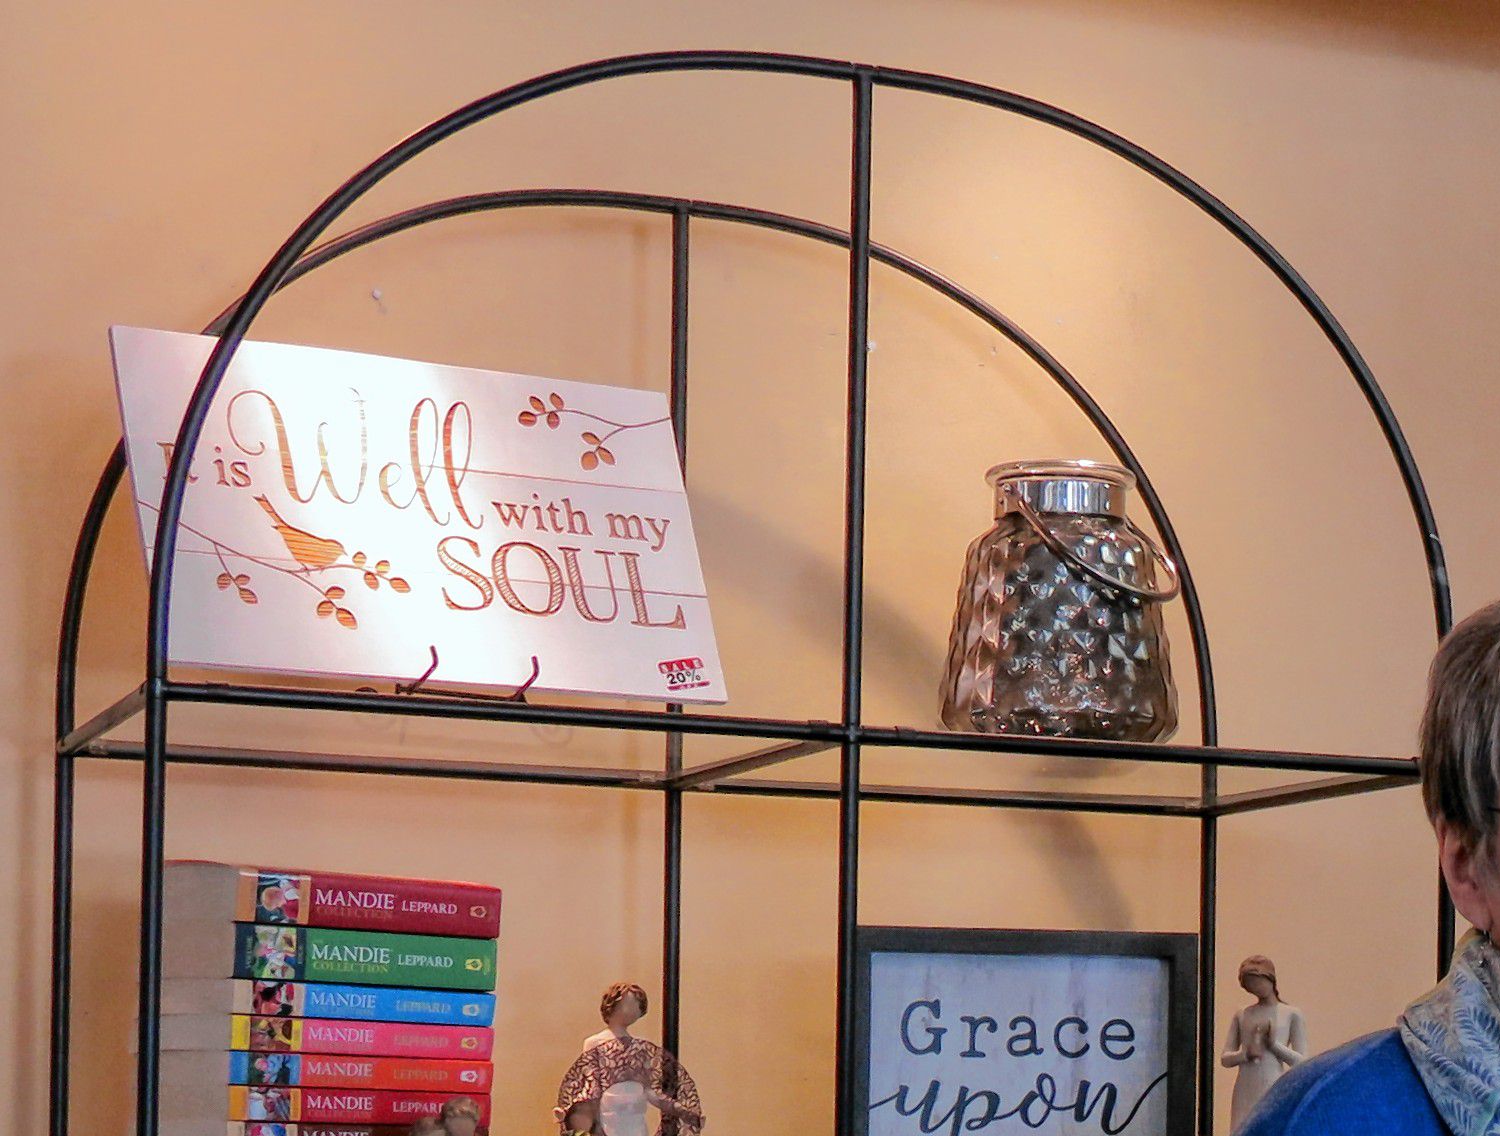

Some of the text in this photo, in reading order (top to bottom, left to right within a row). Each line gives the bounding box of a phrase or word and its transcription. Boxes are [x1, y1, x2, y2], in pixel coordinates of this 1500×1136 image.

[156, 387, 485, 530] I is Well
[491, 493, 671, 552] with my
[437, 536, 687, 630] SOUL
[667, 670, 702, 684] 20%
[315, 888, 458, 915] MANDIE LEPPARD
[311, 943, 454, 969] MANDIE LEPPARD
[313, 960, 389, 974] COLLECTION
[311, 992, 451, 1016] MANDIE LEPPARD
[308, 1027, 374, 1044] MANDIE
[900, 998, 1136, 1060] Grace
[307, 1061, 373, 1077] MANDIE
[307, 1095, 373, 1111] MANDIE
